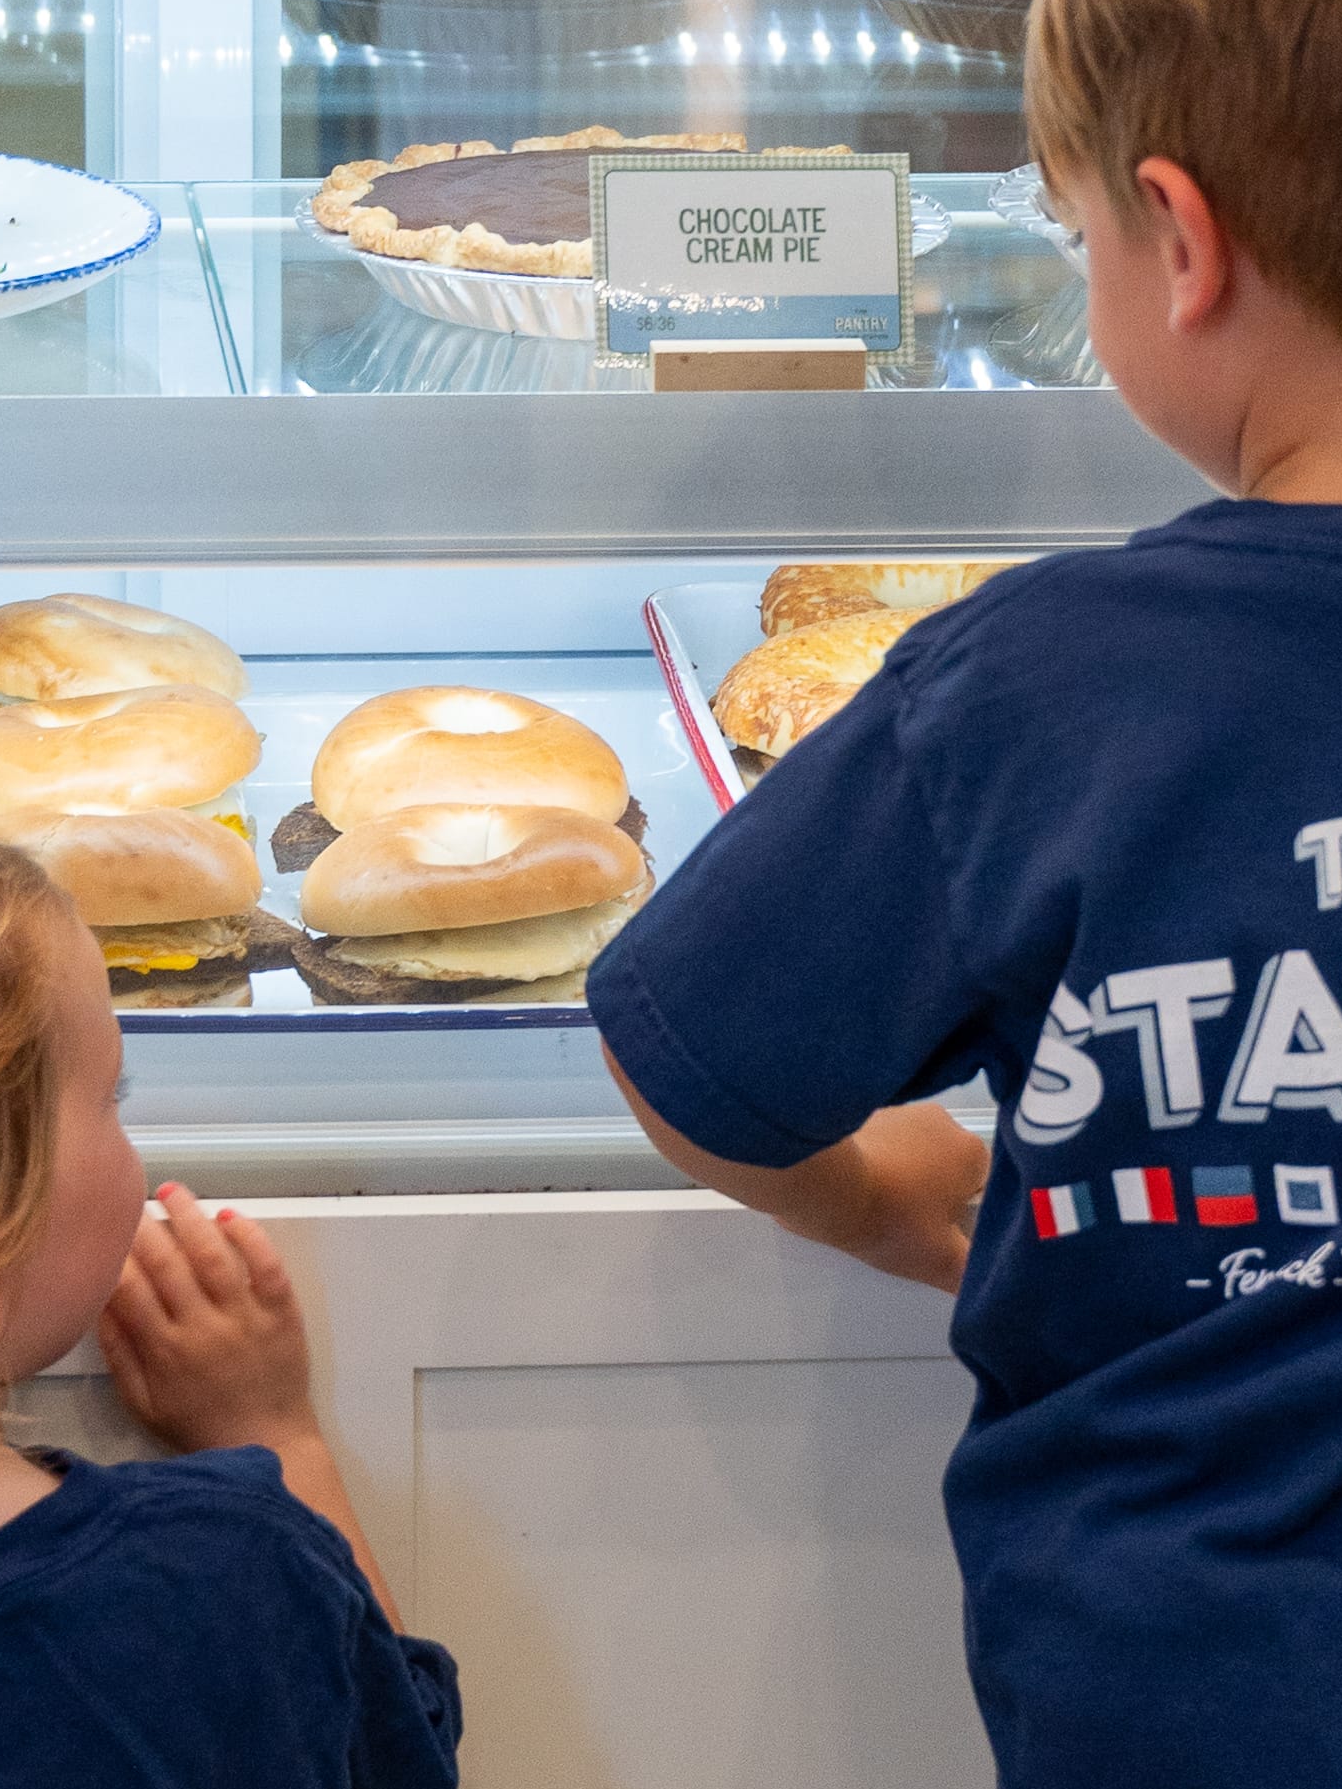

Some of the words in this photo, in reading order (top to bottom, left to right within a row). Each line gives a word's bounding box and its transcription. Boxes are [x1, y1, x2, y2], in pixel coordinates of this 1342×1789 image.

[679, 208, 827, 234] CHOCOLATE
[686, 238, 773, 263] CREAM
[783, 238, 822, 262] PIE
[835, 317, 888, 331] PANTRY
